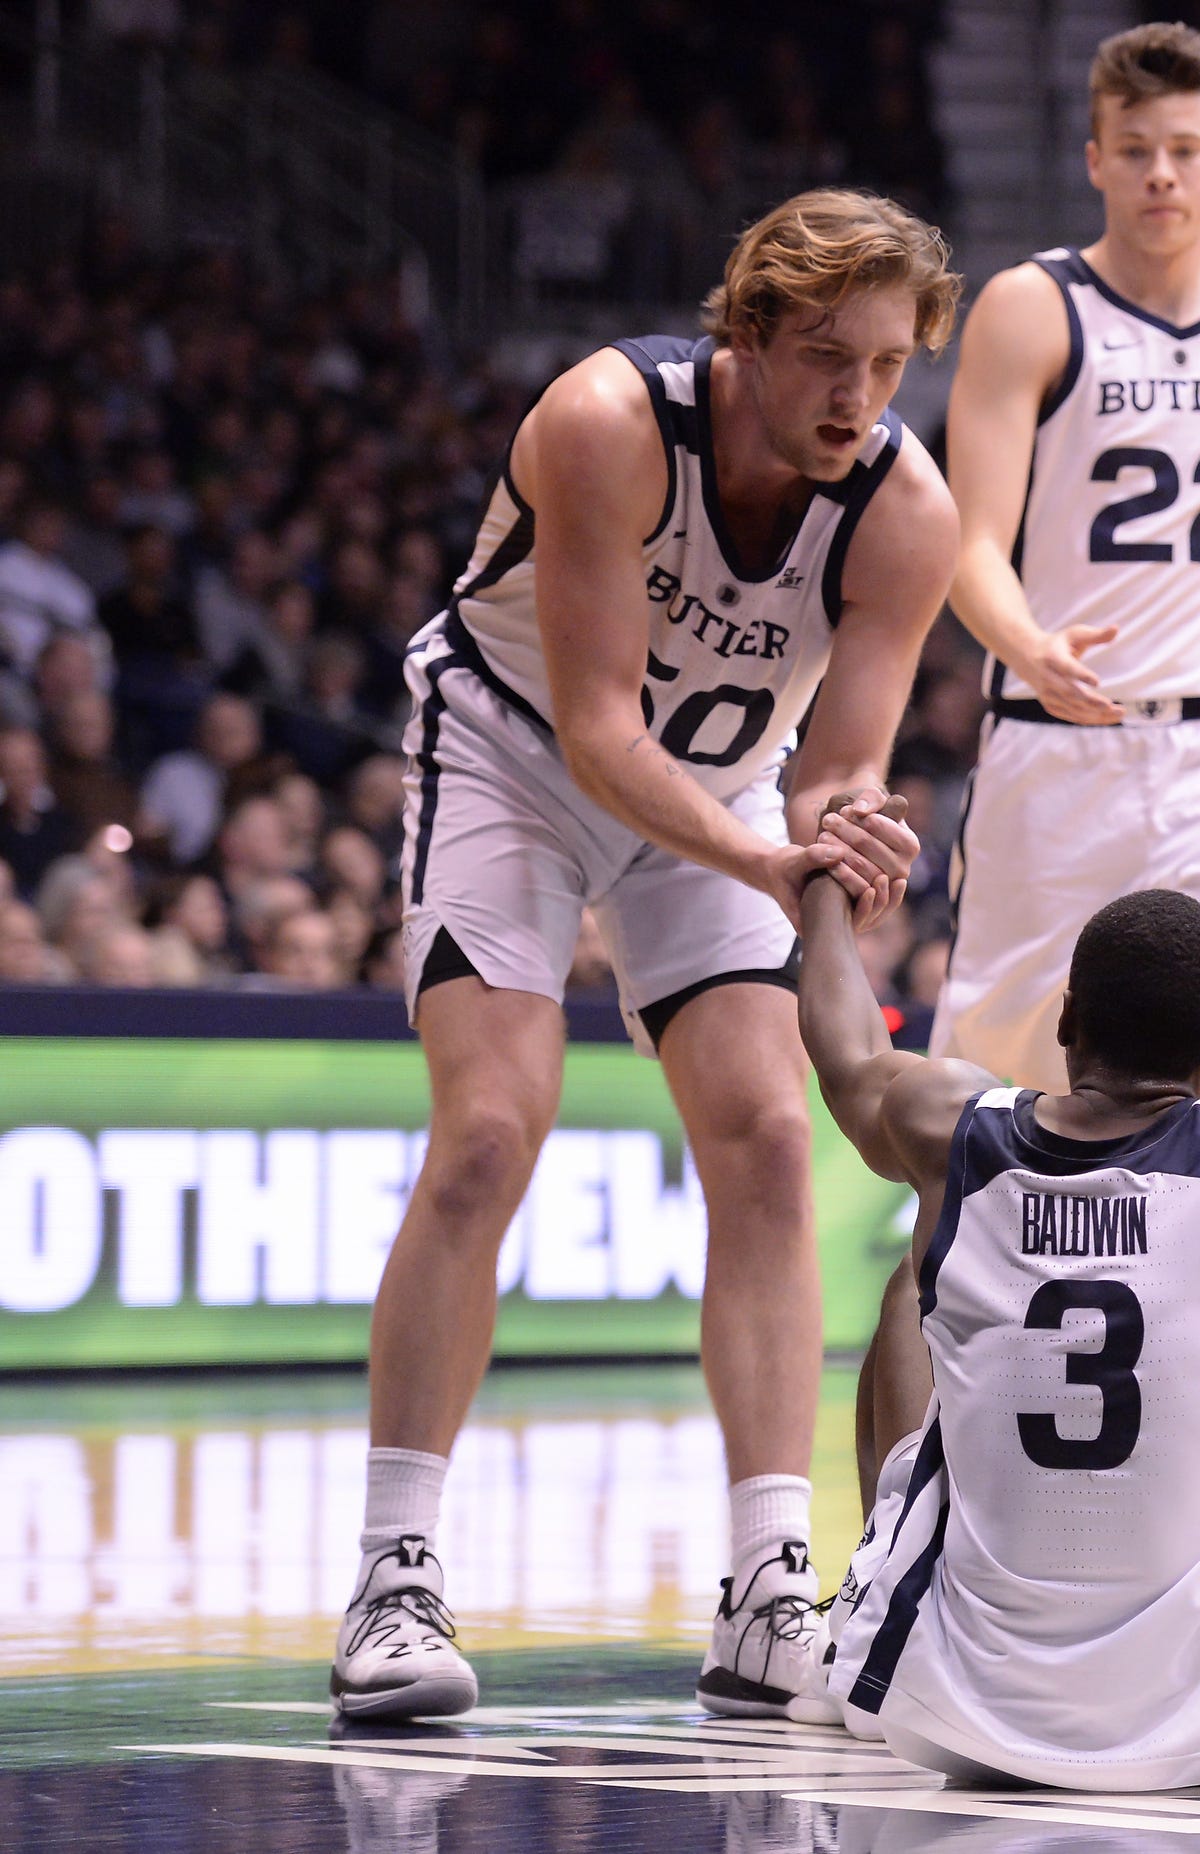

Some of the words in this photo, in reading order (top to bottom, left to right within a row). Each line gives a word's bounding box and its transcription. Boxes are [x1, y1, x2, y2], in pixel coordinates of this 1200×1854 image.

[0, 1126, 708, 1312] OTHEEW
[1021, 1193, 1149, 1256] BALDWIN
[1016, 1279, 1145, 1469] 3
